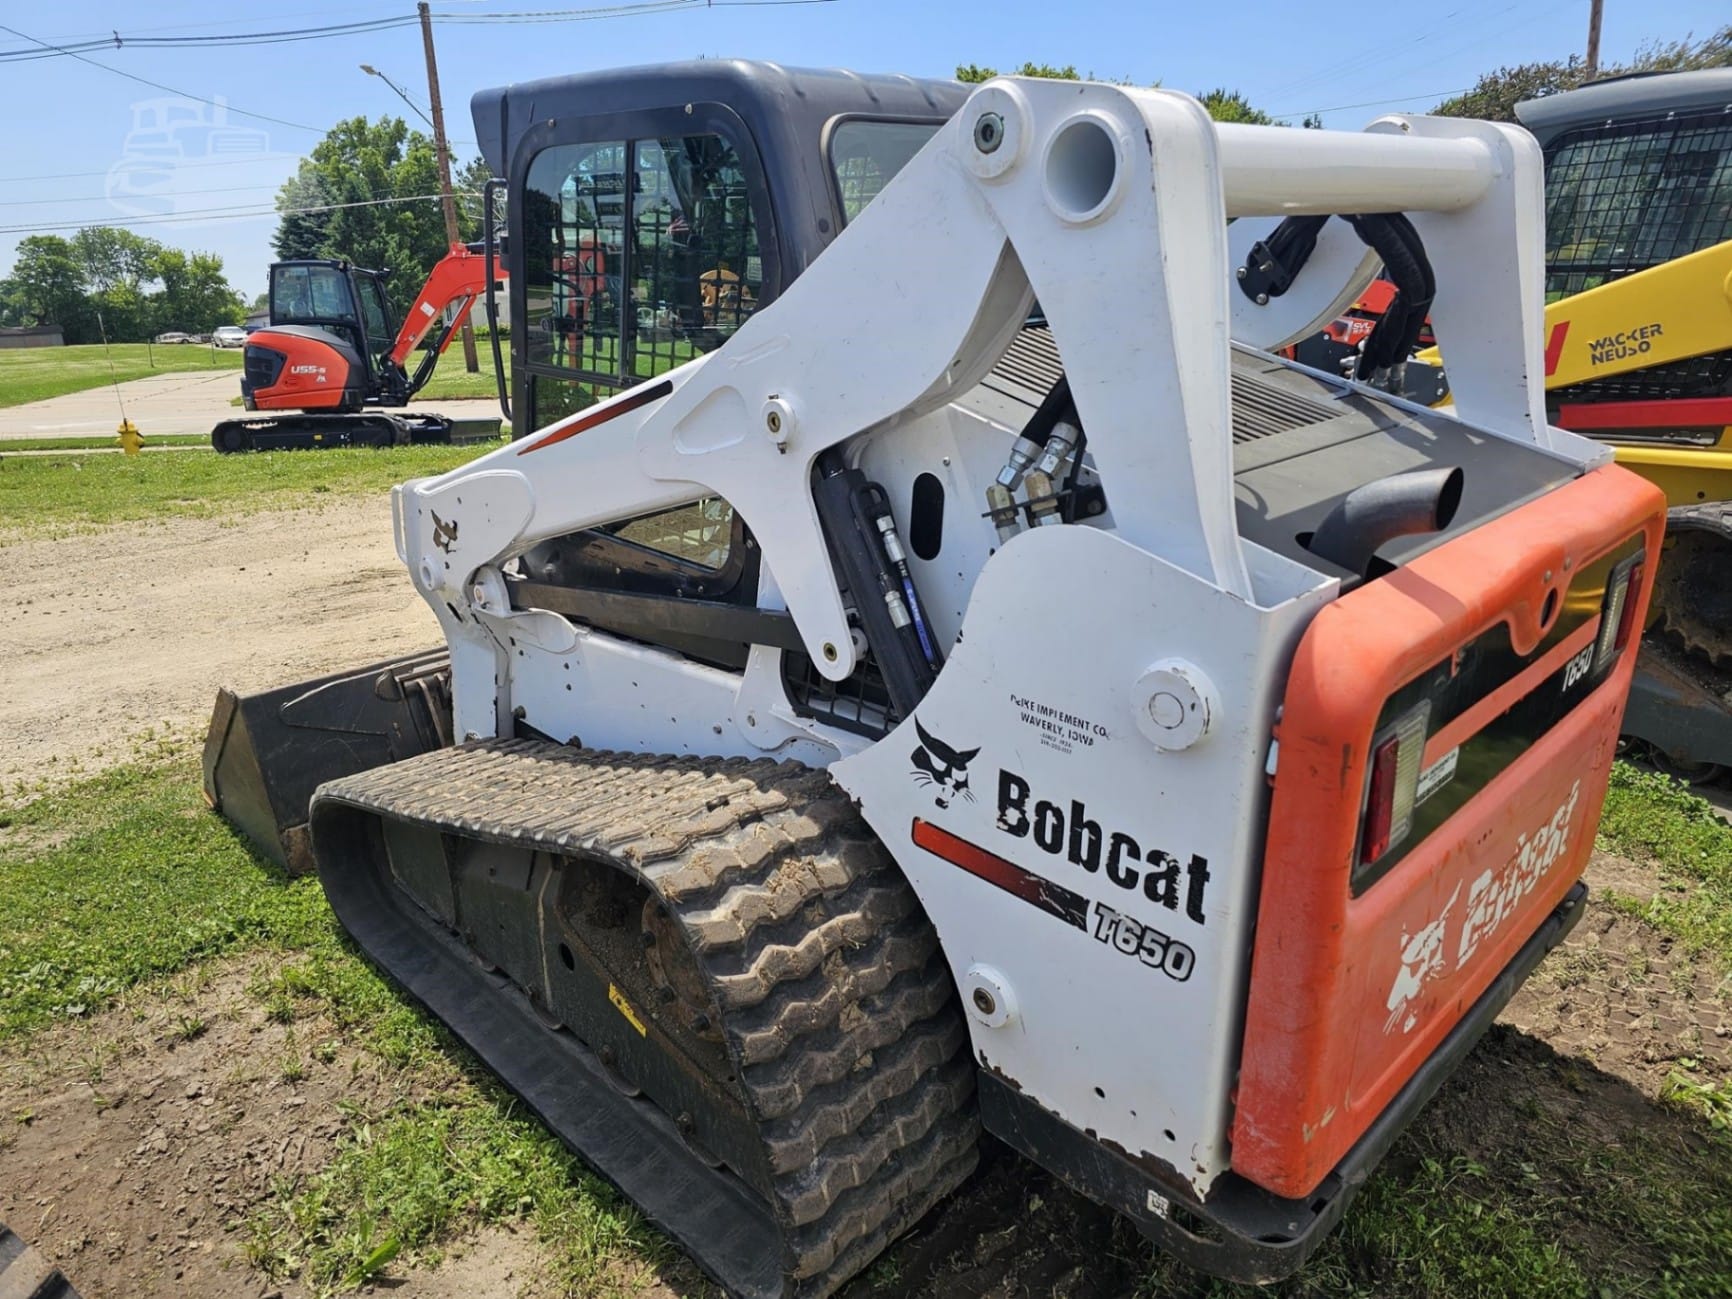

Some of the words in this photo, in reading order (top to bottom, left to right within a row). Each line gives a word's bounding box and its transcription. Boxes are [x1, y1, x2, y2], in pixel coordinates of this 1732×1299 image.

[1588, 323, 1664, 352] WACKER
[1562, 643, 1595, 692] T650
[996, 768, 1211, 926] Bobcat
[1094, 901, 1196, 983] T650
